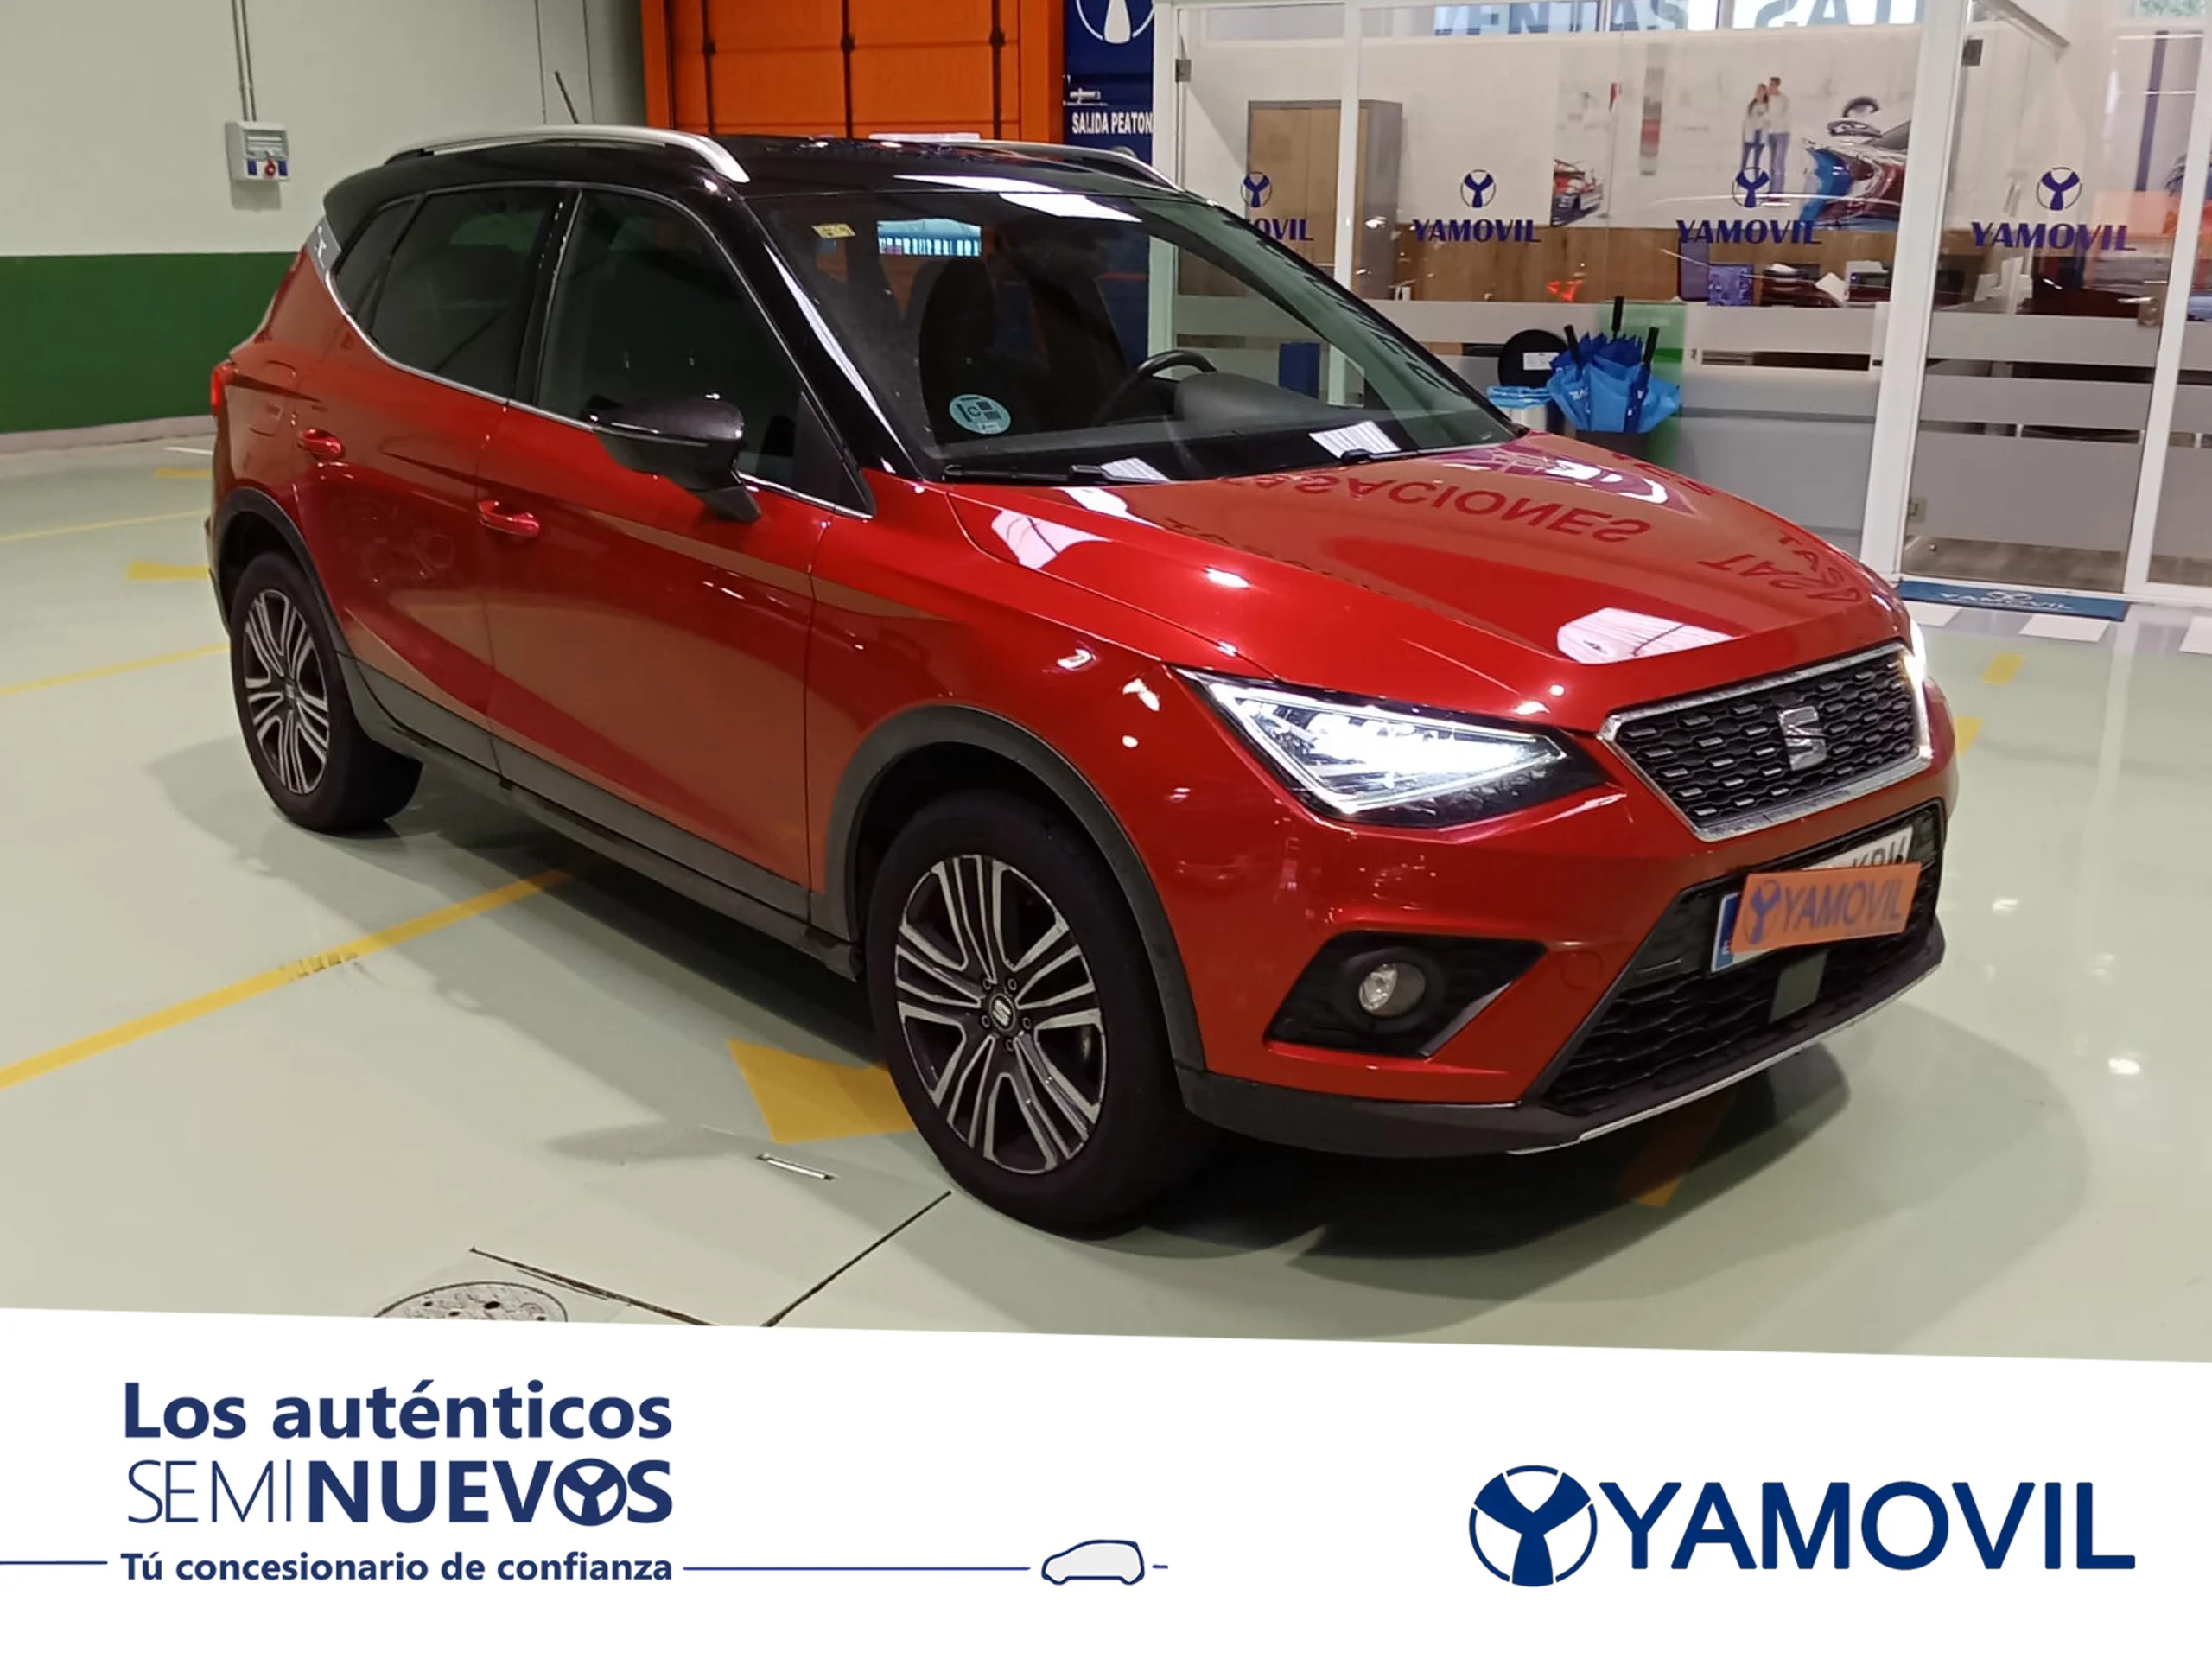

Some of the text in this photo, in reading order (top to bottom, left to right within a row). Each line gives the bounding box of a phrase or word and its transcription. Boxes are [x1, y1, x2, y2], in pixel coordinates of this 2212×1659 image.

[1071, 111, 1154, 134] SALIDA PEATON
[1412, 219, 1542, 243] YAMOVIL
[1675, 219, 1822, 245] YAMOVIL
[1970, 221, 2138, 251] YAMOVIL
[1782, 878, 1904, 934] YAMOVIL
